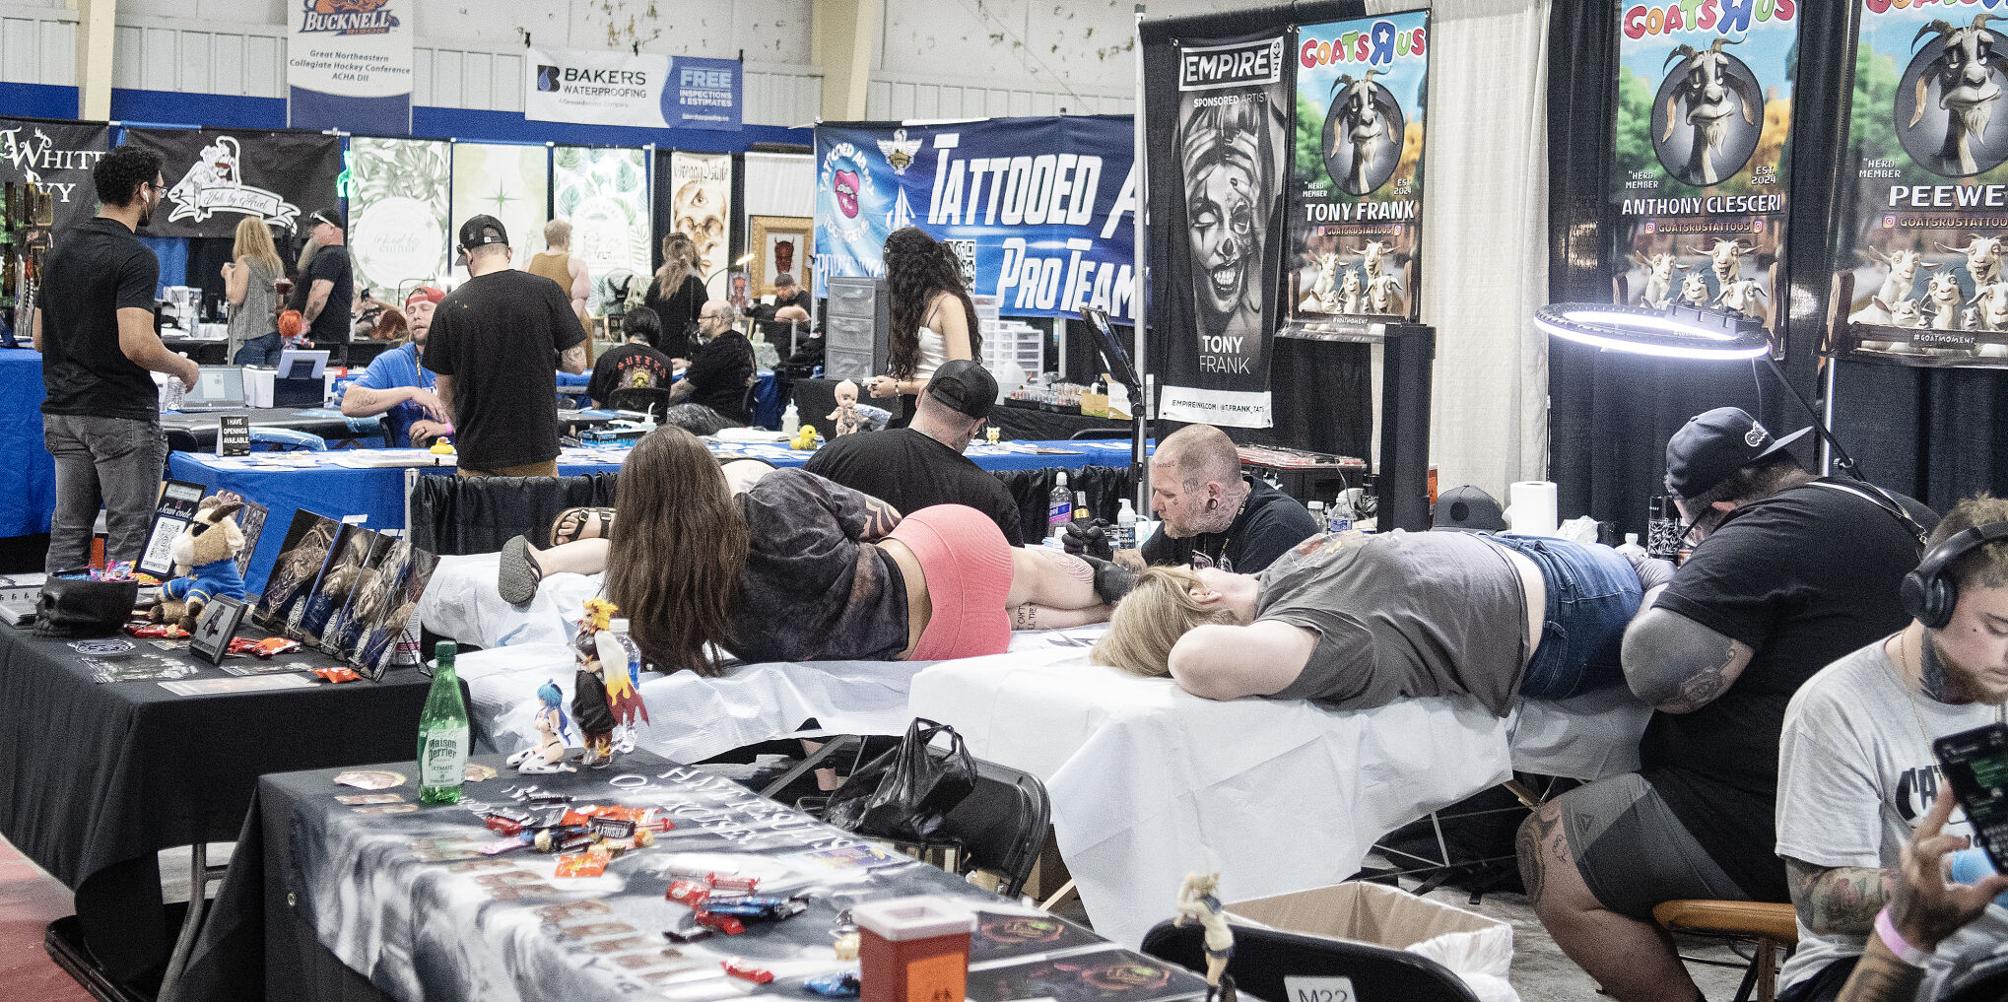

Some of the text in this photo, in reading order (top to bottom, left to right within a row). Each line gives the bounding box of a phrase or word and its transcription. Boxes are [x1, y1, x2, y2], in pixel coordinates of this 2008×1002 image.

[303, 11, 390, 31] BUCKNELL
[1624, 0, 1717, 39] GOATS
[1300, 31, 1370, 68] GOATS
[1395, 28, 1426, 56] US
[310, 50, 389, 62] Great Northeastern
[290, 59, 411, 74] Collegiate Hockey Conference
[1186, 48, 1269, 81] EMPIRE
[332, 72, 355, 80] ACHA
[564, 68, 646, 85] BAKERS
[680, 70, 732, 88] FREE
[564, 85, 647, 98] WATERPROOFING
[680, 90, 732, 98] INSPECTIONS
[687, 98, 732, 107] ESTIMATES
[1193, 92, 1269, 108] SPONSORED ARTIST
[927, 132, 1103, 226] TATTOOED
[1751, 176, 1776, 185] 2024
[1859, 169, 1902, 178] MEMBER
[1393, 187, 1412, 195] 2024
[1625, 181, 1658, 189] MEMBER
[1302, 190, 1328, 198] MEMBER
[1889, 184, 2006, 207] PEEWE
[1305, 200, 1416, 222] TONY FRANK
[1622, 194, 1781, 215] ANTHONY CLESCERI
[1658, 222, 1750, 233] GOATSRUSTATTOOS
[1202, 335, 1244, 354] TONY
[1913, 333, 1975, 344] #GOATMOMENT
[1200, 355, 1250, 375] FRANK
[223, 427, 248, 435] OPENINGS
[223, 436, 249, 444] AVAILABLE
